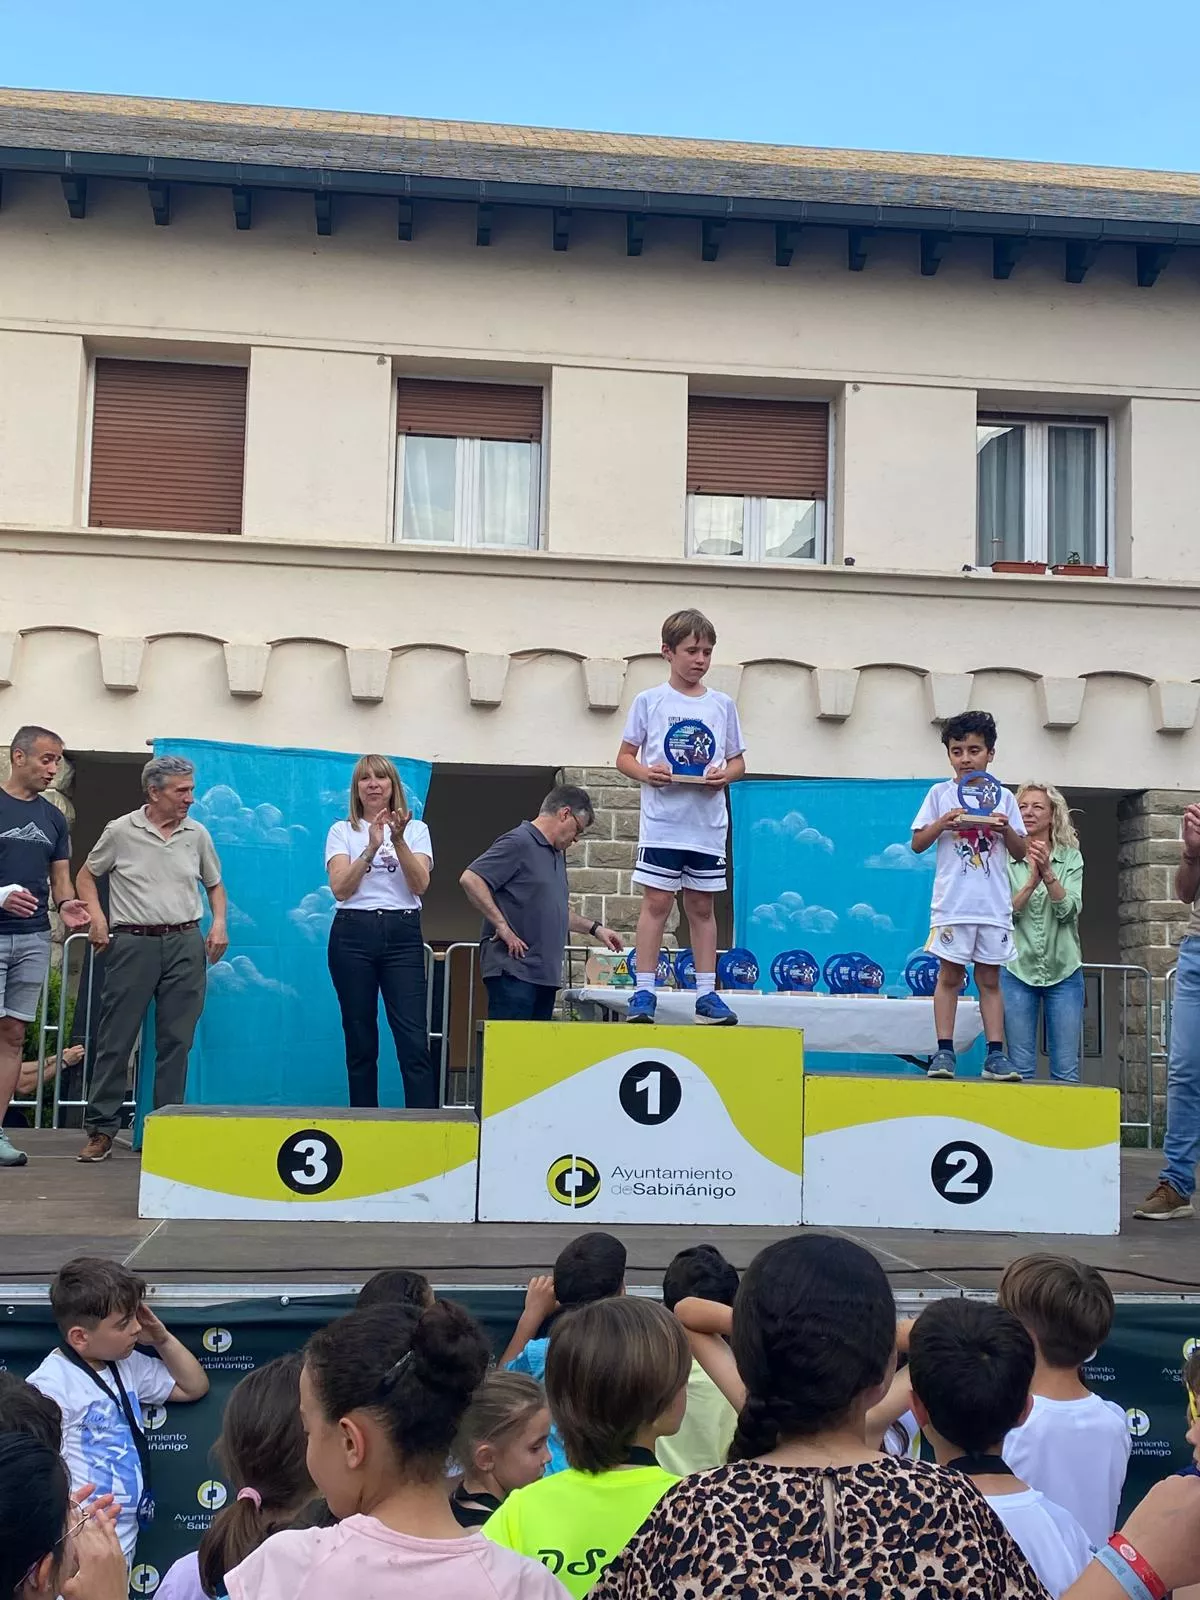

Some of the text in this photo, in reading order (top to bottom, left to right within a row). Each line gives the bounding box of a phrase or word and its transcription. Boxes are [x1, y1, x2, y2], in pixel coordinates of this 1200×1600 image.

[636, 1071, 661, 1115] 1
[291, 1139, 328, 1185] 3
[611, 1165, 734, 1181] Ayuntamiento
[944, 1150, 979, 1194] 2
[199, 1355, 253, 1363] ntamiento
[203, 1363, 256, 1371] abiñánigo
[146, 1433, 188, 1442] amiento
[148, 1442, 189, 1452] iñánigo
[1132, 1441, 1170, 1449] amiento
